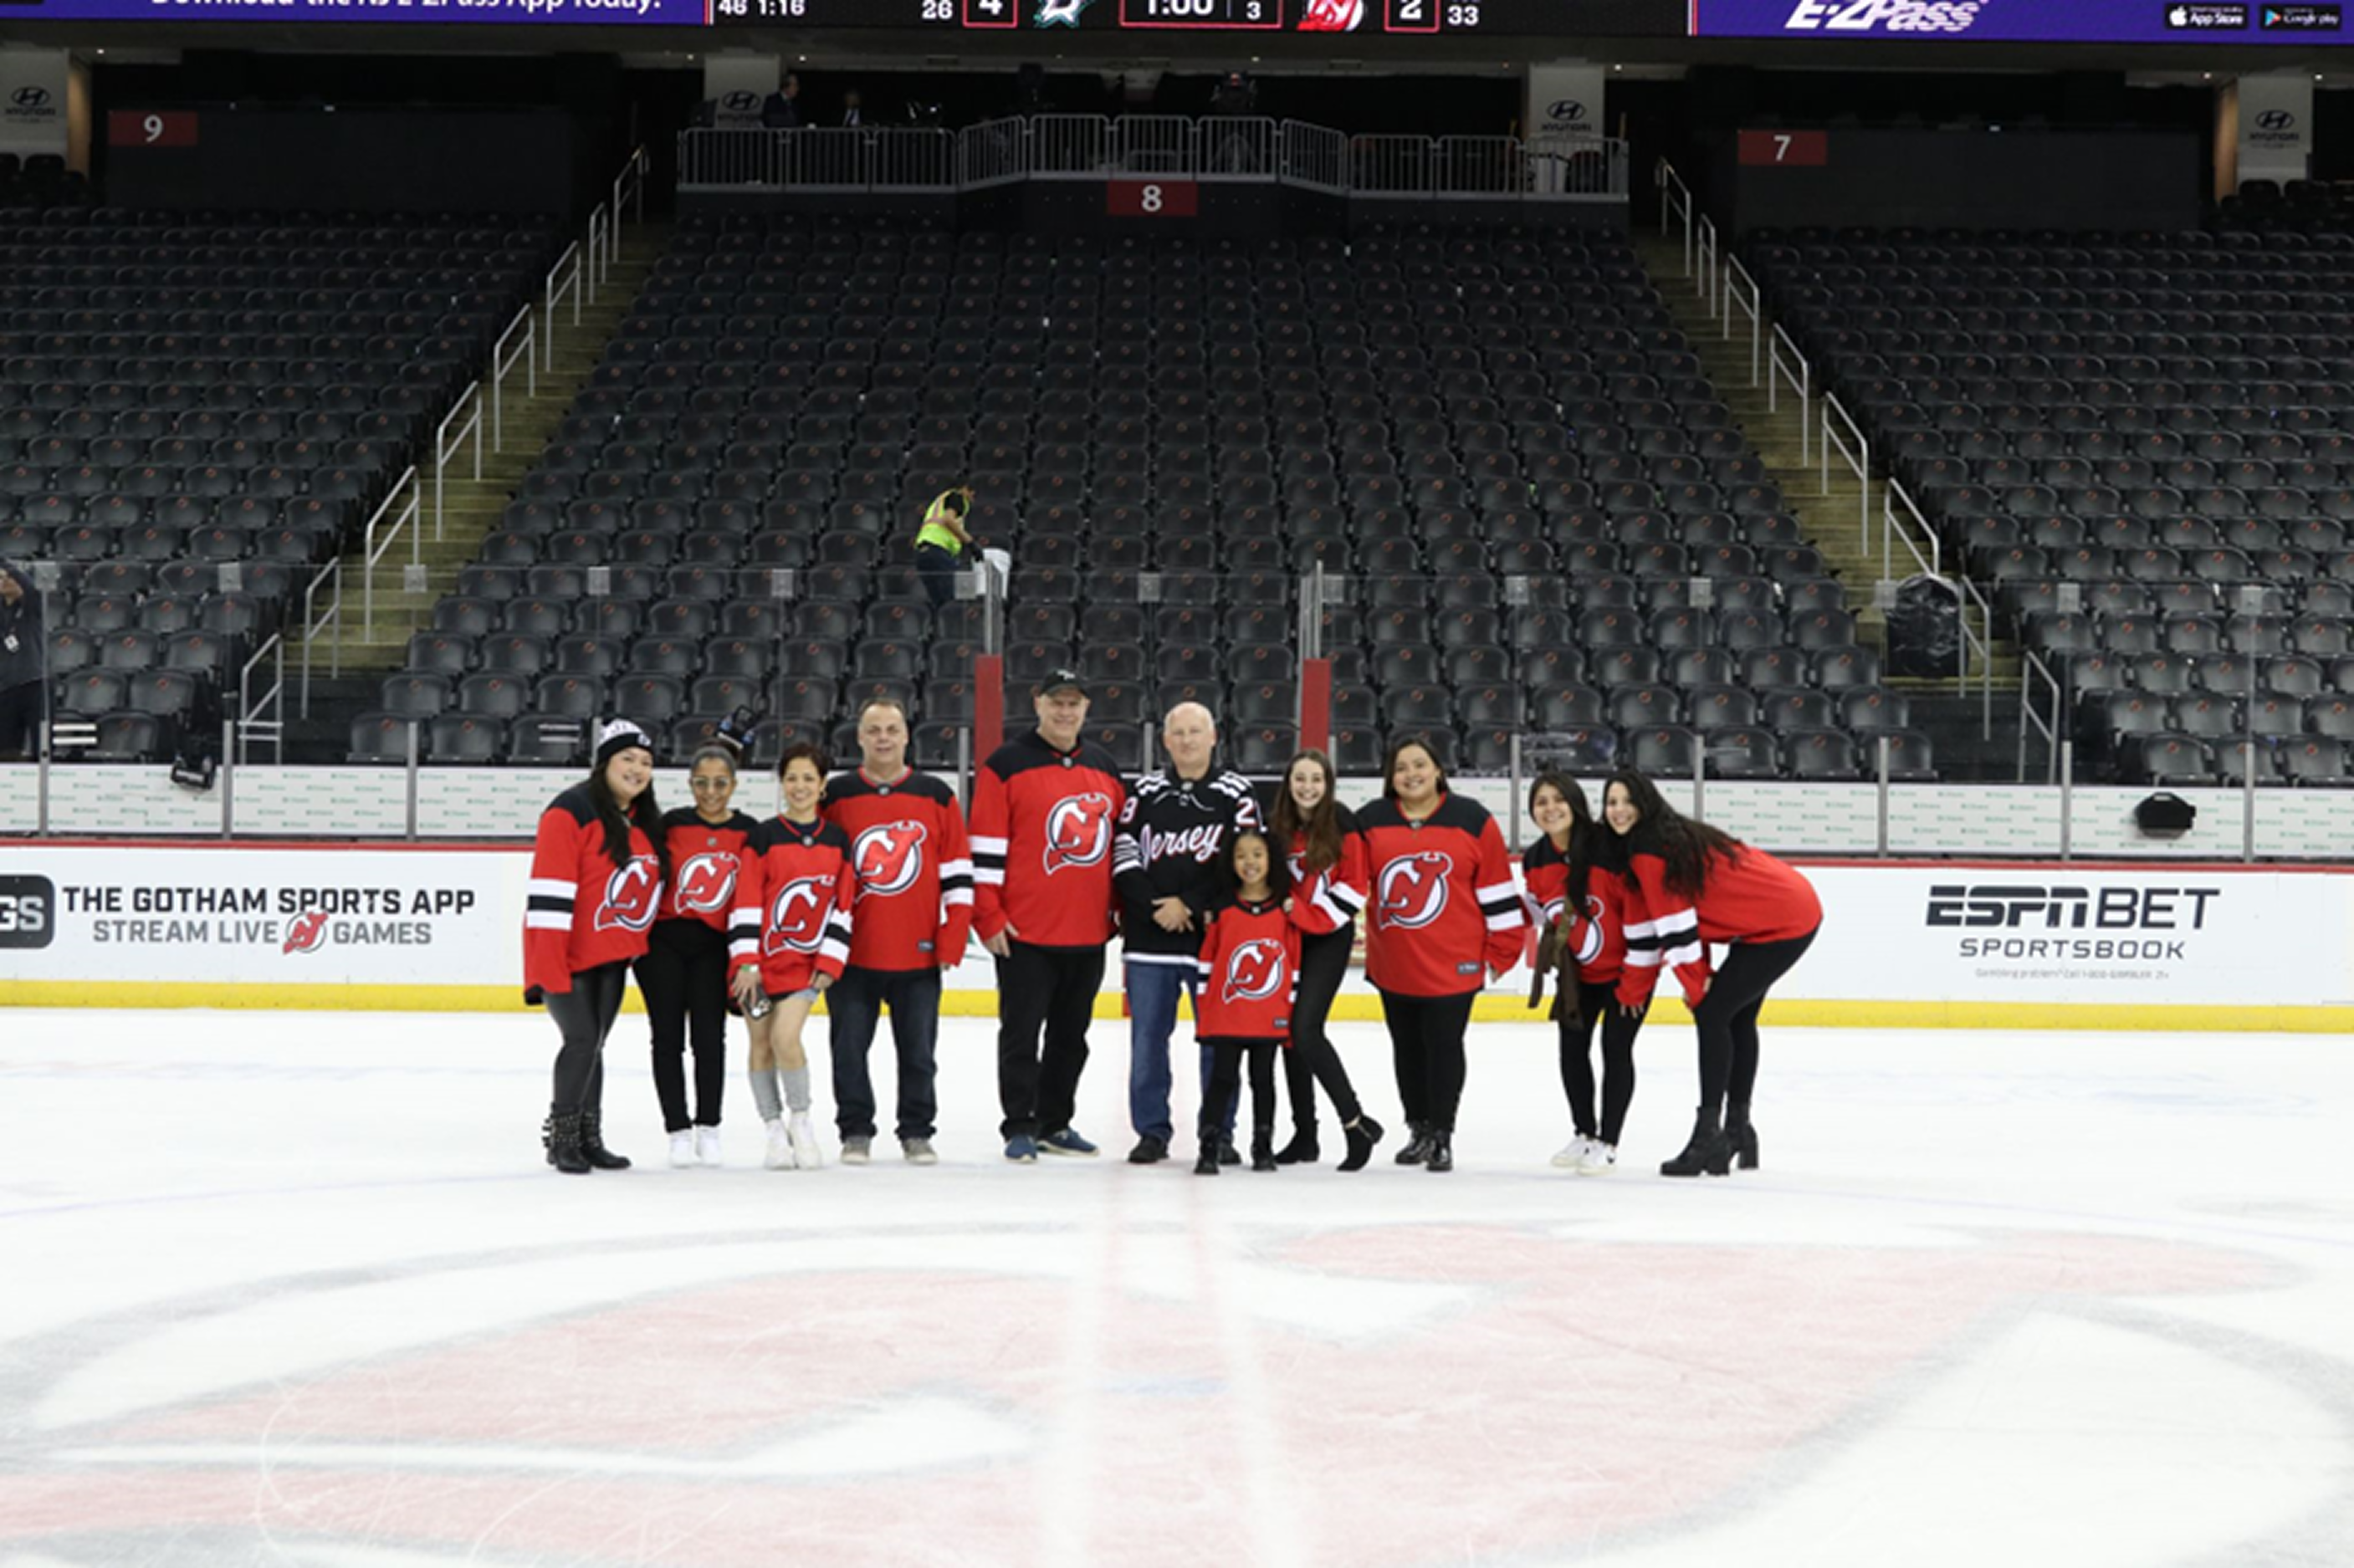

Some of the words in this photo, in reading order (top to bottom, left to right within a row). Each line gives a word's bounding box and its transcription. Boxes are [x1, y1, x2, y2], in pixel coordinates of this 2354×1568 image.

[719, 0, 747, 15] 46
[979, 0, 1002, 15] 4
[1246, 1, 1261, 19] 3
[1400, 0, 1422, 19] 2
[1447, 5, 1479, 25] 33
[143, 115, 164, 142] 9
[1773, 135, 1792, 161] 7
[1141, 184, 1163, 212] 8
[1140, 823, 1224, 871] Jersey
[63, 886, 122, 913] THE
[133, 886, 267, 913] GOTHAM
[278, 888, 401, 914] SPORTS
[411, 889, 474, 914] APP
[0, 896, 44, 931] GS
[94, 920, 208, 942] STREAM
[219, 920, 278, 943] LIVE
[333, 922, 432, 945] GAMES
[1959, 937, 2186, 959] SPORTSBOOK
